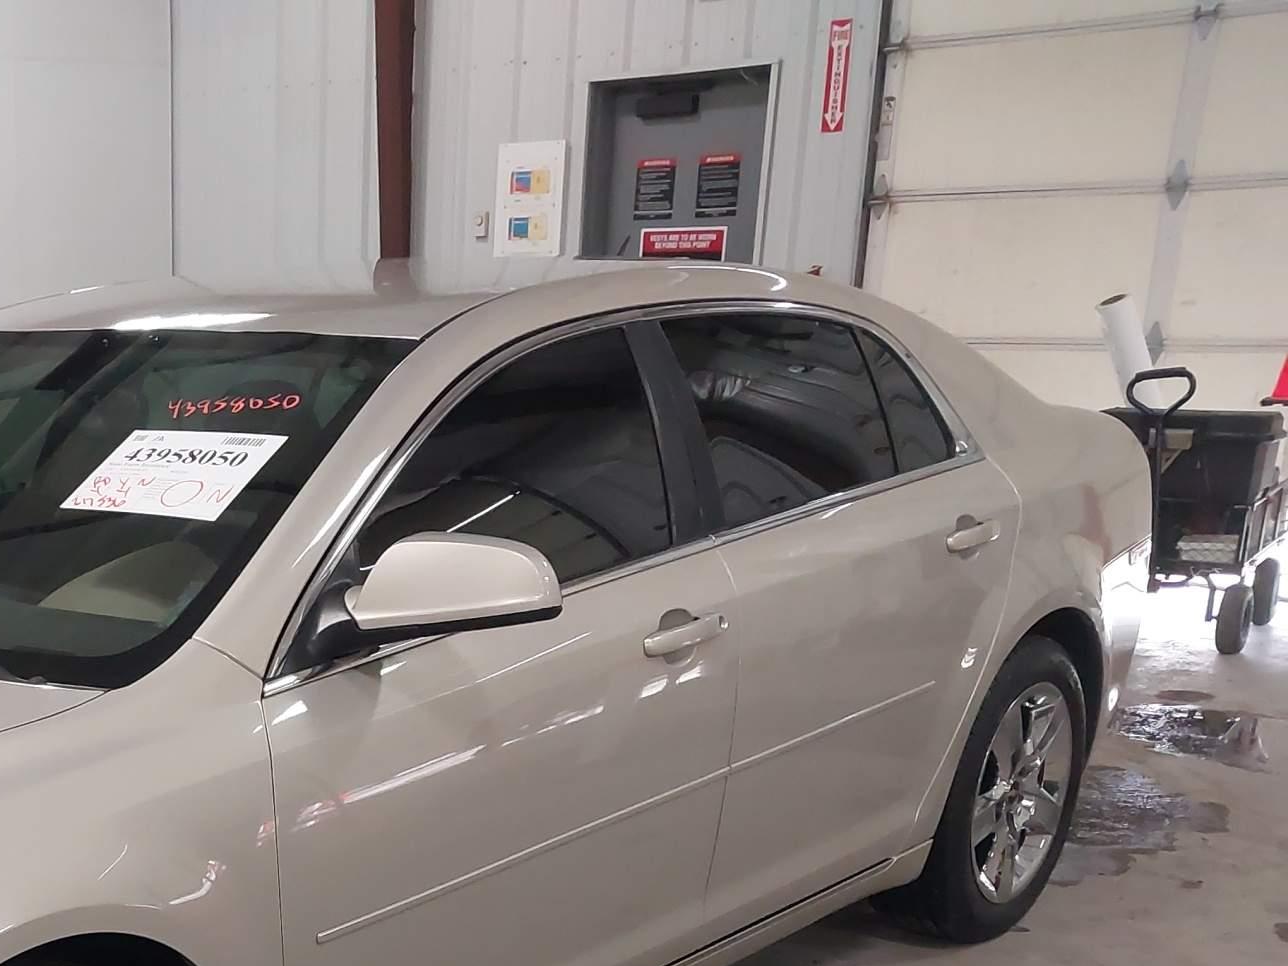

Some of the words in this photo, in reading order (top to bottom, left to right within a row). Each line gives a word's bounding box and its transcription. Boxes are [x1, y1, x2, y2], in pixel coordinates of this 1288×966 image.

[830, 44, 843, 124] EXTINGUISHER
[168, 394, 301, 418] 43958050
[124, 447, 248, 467] 43958050
